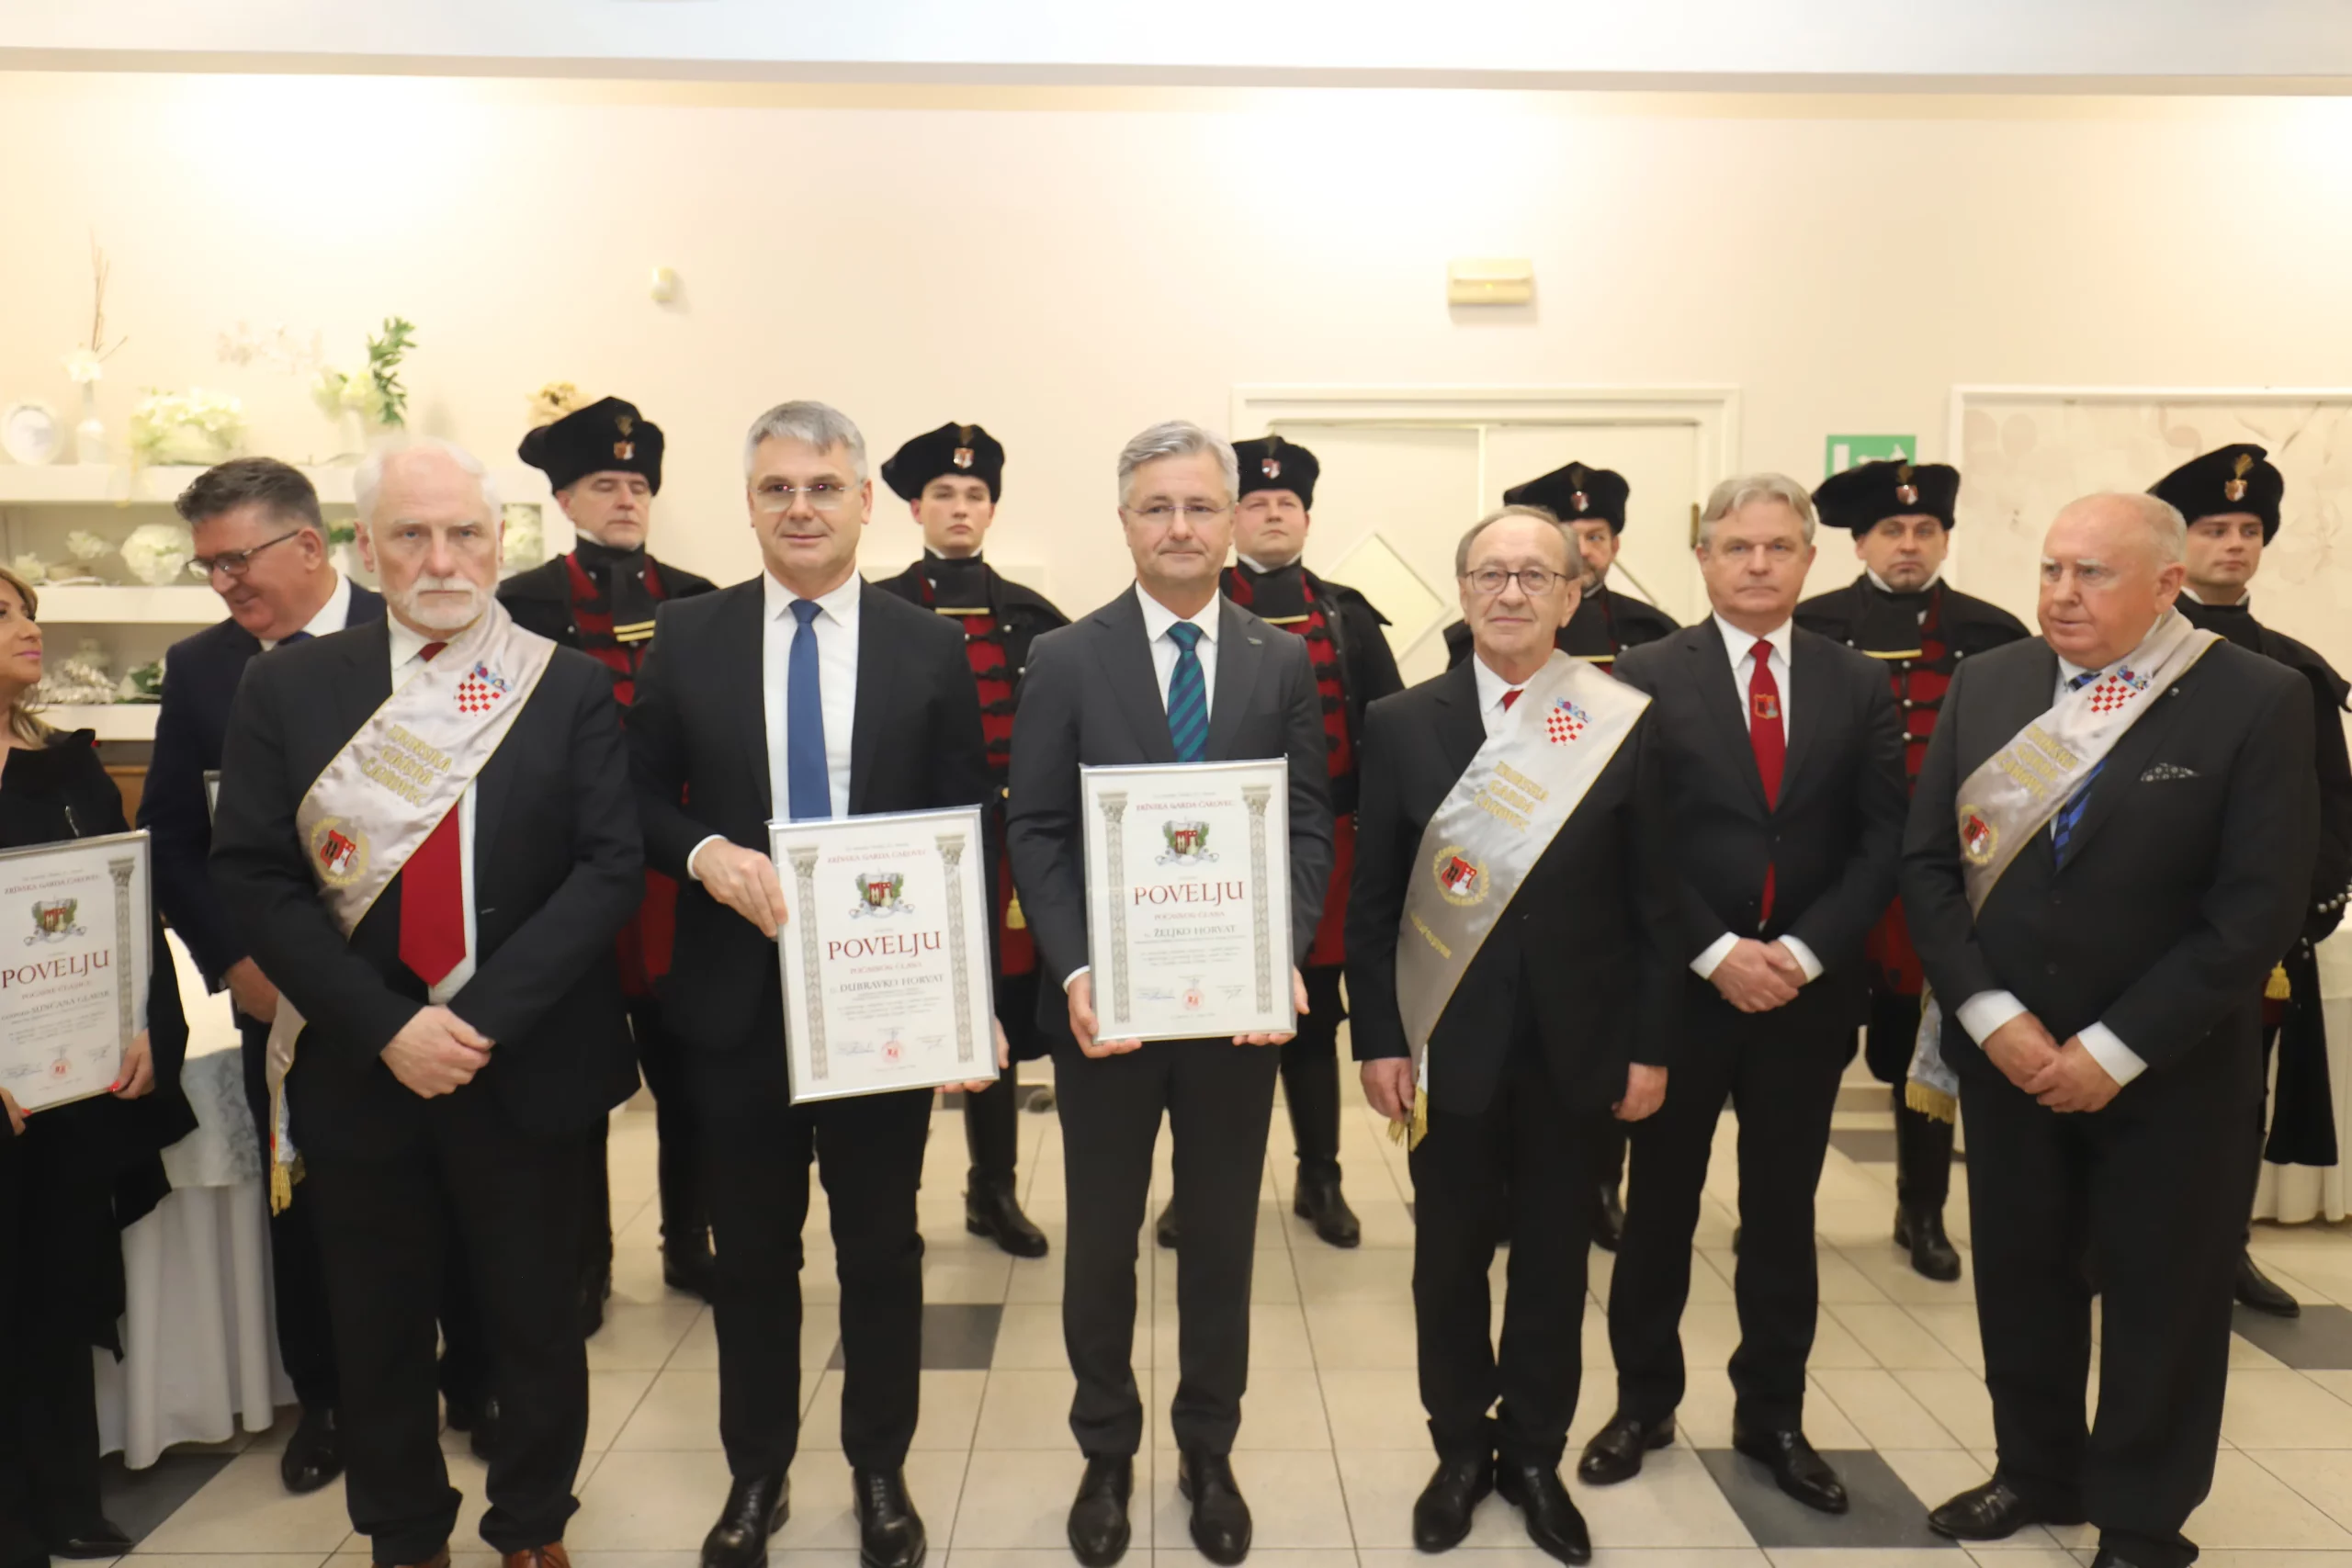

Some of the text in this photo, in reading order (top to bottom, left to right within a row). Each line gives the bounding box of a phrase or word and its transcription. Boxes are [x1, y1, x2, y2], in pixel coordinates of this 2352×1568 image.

[380, 745, 434, 786] GARDA
[1489, 780, 1534, 814] GARDA
[1134, 881, 1243, 907] POVELJU
[827, 931, 941, 960] POVELJU
[1154, 928, 1191, 938] ŽELJKO
[1194, 925, 1236, 935] HORVAT
[3, 950, 108, 988] POVELJU
[840, 979, 899, 992] DUBRAVKO
[902, 974, 944, 986] HORVAT
